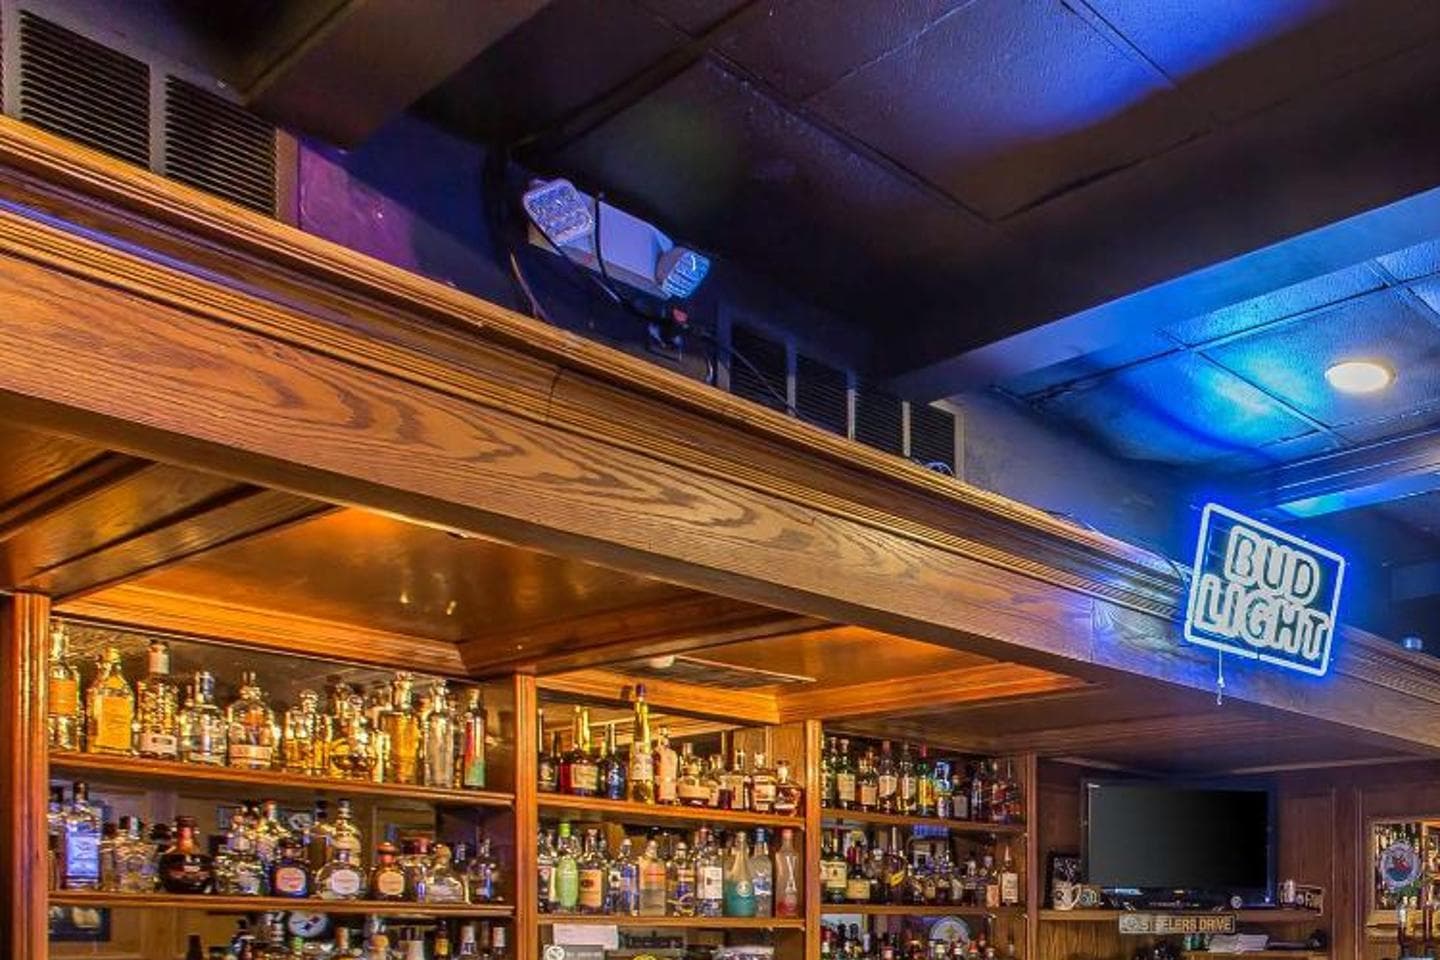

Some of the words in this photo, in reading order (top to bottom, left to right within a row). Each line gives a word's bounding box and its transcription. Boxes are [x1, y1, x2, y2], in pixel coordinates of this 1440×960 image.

[1225, 525, 1320, 606] BUD
[1194, 573, 1331, 660] LIGHT
[1200, 918, 1231, 931] DRIVE
